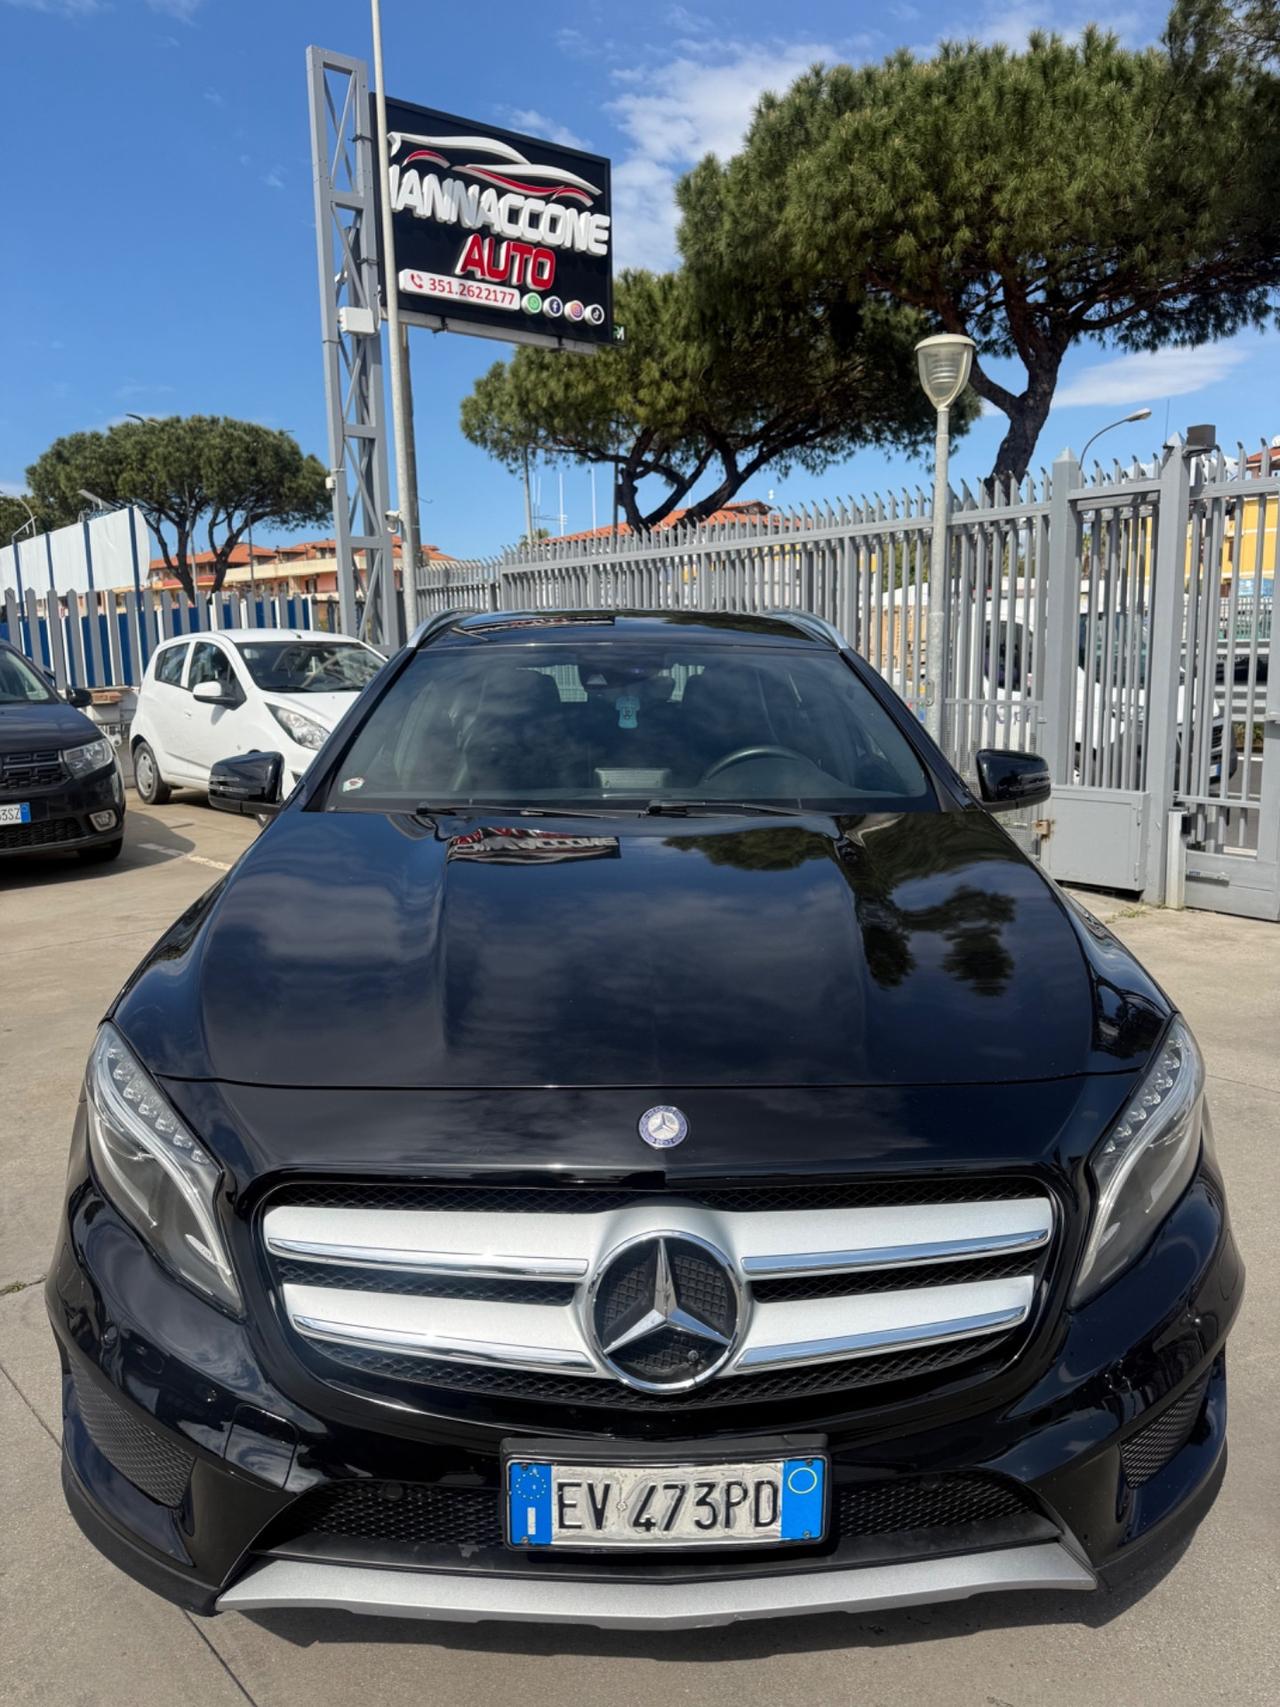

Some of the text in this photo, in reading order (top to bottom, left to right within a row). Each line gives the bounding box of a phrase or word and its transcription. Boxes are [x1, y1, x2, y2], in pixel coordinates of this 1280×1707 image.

[389, 164, 611, 256] IANNACCONE
[455, 233, 556, 290] AUTO
[428, 277, 516, 306] 351.2622177
[0, 807, 20, 821] 3SZ
[557, 1480, 779, 1532] EV 473PD
